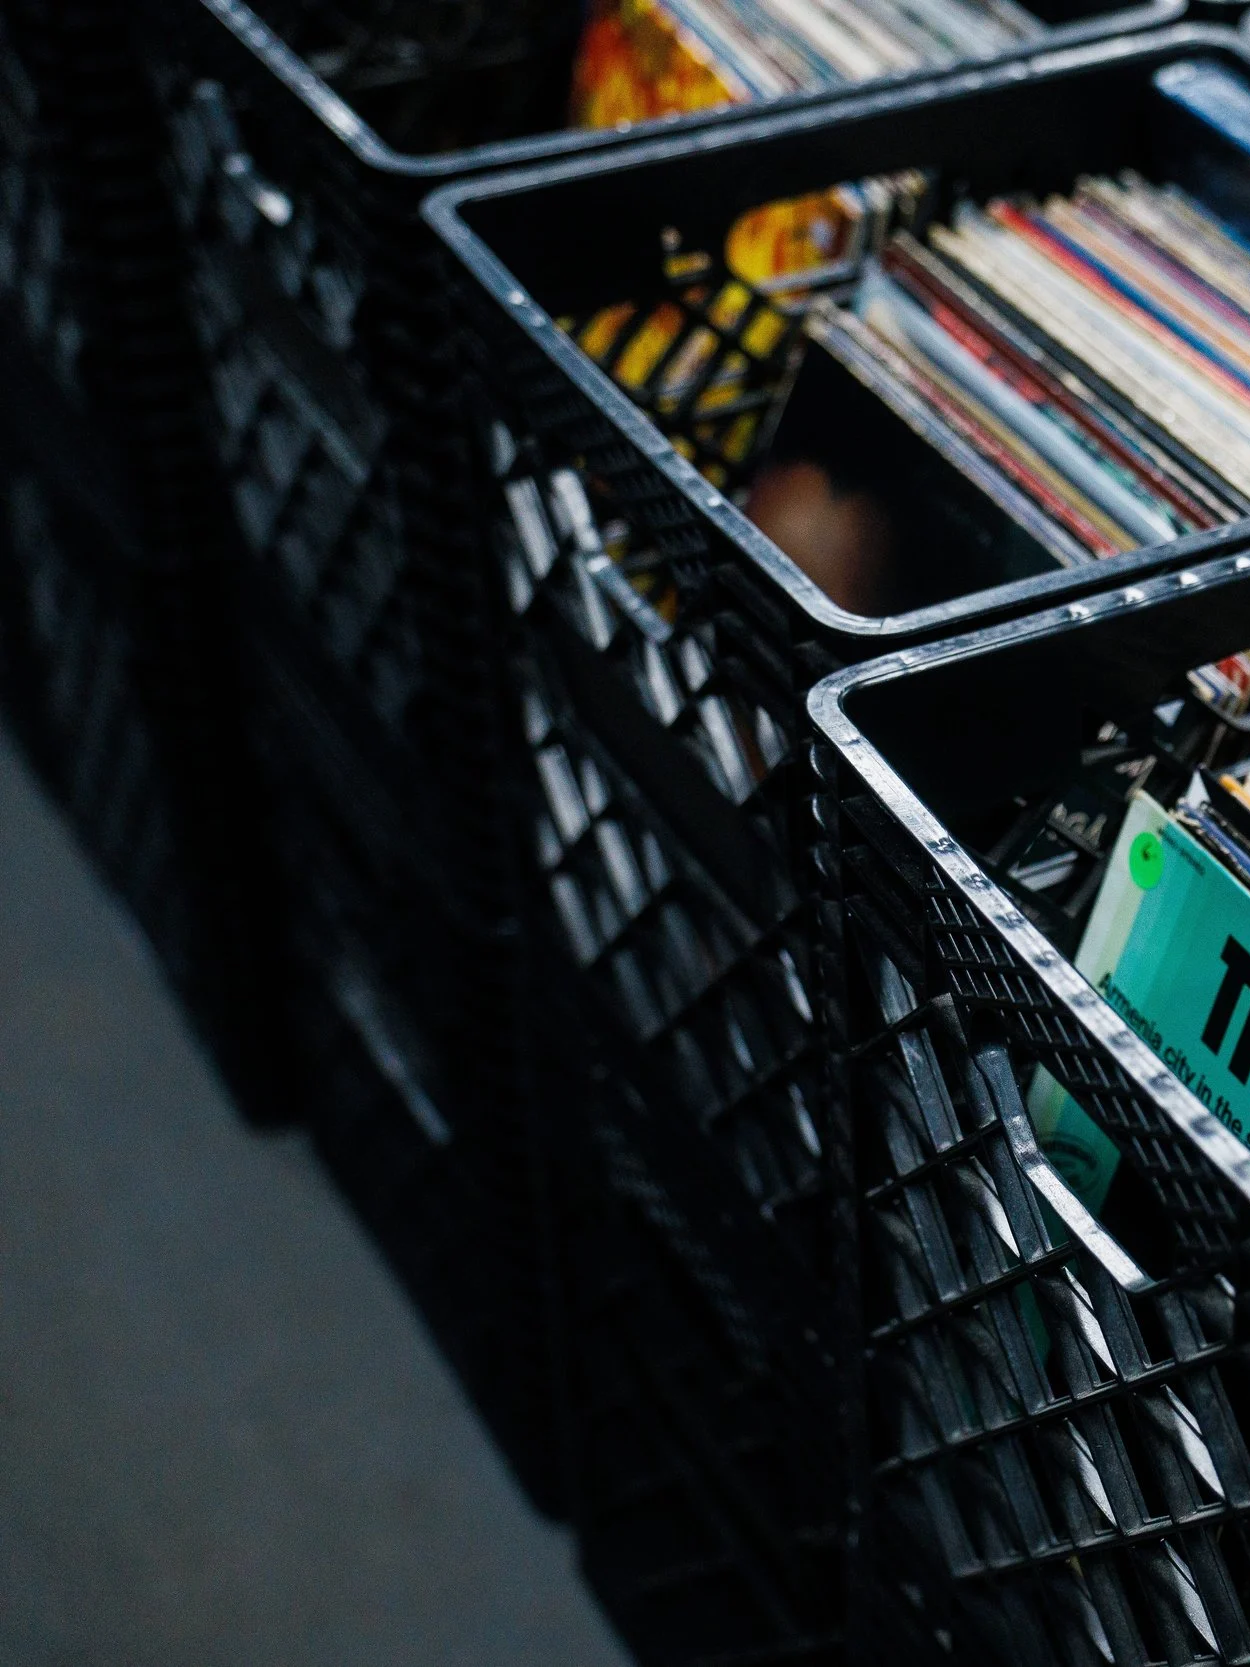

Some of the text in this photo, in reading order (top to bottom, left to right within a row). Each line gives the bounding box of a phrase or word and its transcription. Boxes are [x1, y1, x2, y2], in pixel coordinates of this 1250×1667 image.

[1098, 972, 1163, 1051] Armenia
[1163, 1046, 1197, 1088] city
[1195, 1074, 1213, 1104] in
[1216, 1095, 1243, 1136] the
